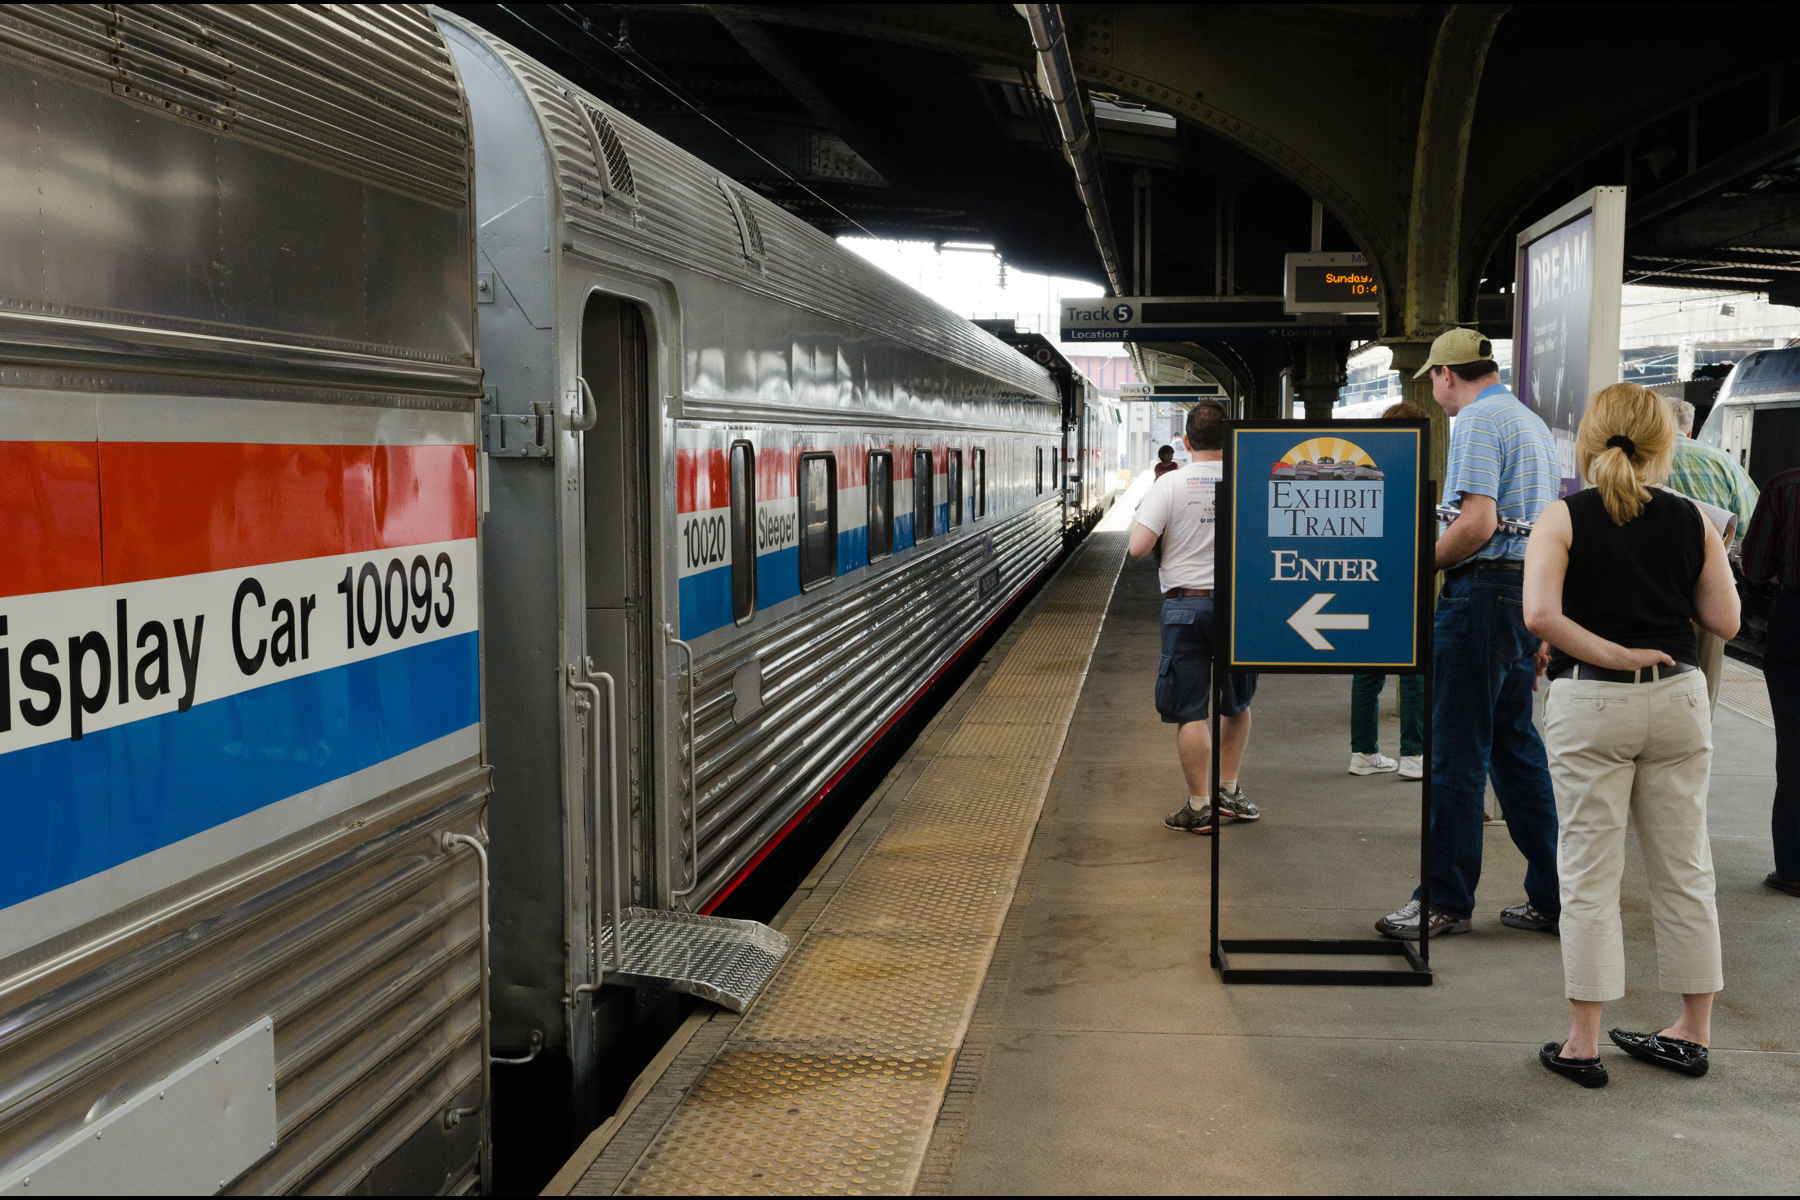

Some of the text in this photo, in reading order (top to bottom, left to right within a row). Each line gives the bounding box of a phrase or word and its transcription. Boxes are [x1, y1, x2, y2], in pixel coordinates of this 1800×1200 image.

[1533, 232, 1588, 308] DREAM
[1067, 306, 1129, 321] Track 5
[1071, 329, 1129, 339] Location F
[1272, 481, 1382, 509] EXHIBIT
[683, 506, 796, 568] 10020 Sleeper
[1284, 509, 1366, 536] TRAIN
[1270, 550, 1380, 582] ENTER
[0, 552, 455, 741] isplay Car 10093
